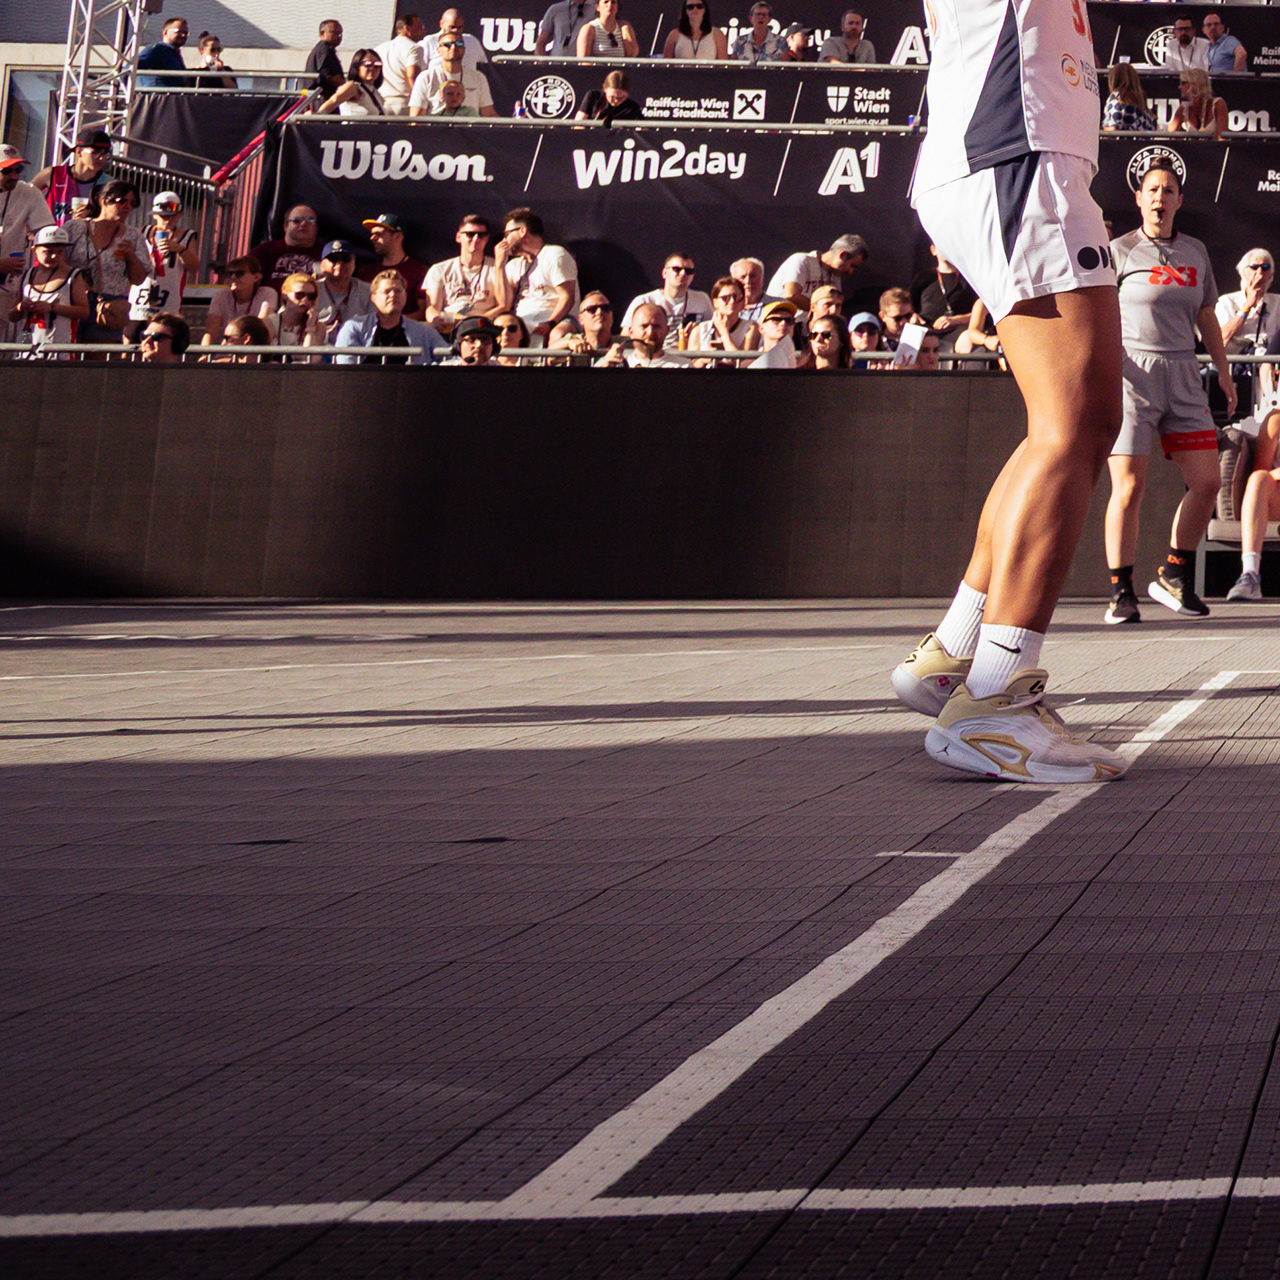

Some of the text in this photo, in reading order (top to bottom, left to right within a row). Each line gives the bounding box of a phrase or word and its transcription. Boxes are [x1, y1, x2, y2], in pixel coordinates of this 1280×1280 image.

[891, 26, 930, 66] A
[525, 78, 573, 102] ALFA ROMEO
[854, 86, 891, 101] Stadt
[645, 97, 729, 110] Raiffeisen Wien
[672, 108, 729, 119] Stadtbank
[854, 101, 890, 113] Wien
[320, 140, 488, 183] Wilson
[573, 139, 746, 190] win2day
[818, 142, 880, 197] A1
[1130, 148, 1183, 177] ALFA ROMEO
